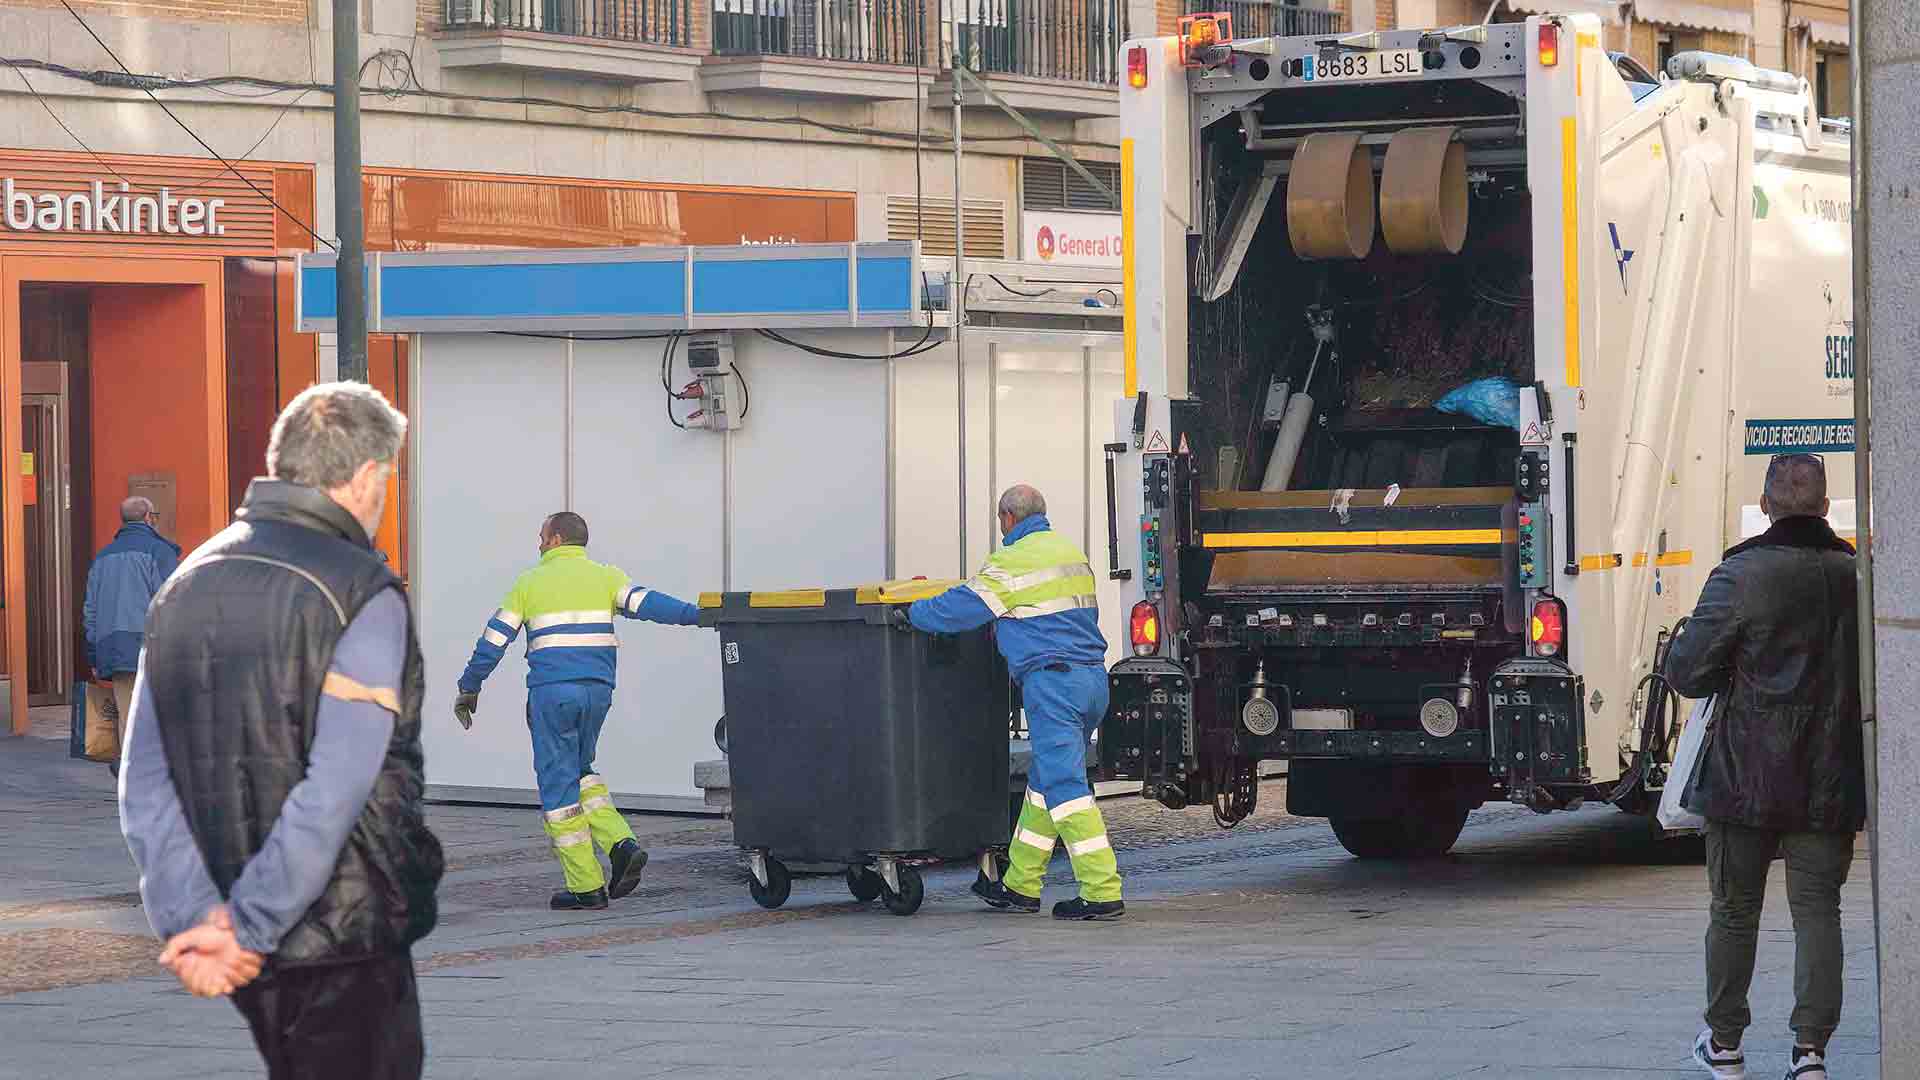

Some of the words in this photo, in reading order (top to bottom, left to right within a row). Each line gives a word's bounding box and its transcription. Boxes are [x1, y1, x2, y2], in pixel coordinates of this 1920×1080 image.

[1317, 56, 1368, 78] 8683
[1380, 53, 1418, 74] LSL
[1059, 233, 1110, 257] General
[1768, 426, 1781, 445] DE
[1781, 425, 1823, 446] RECOGIDA
[1824, 425, 1837, 444] DE
